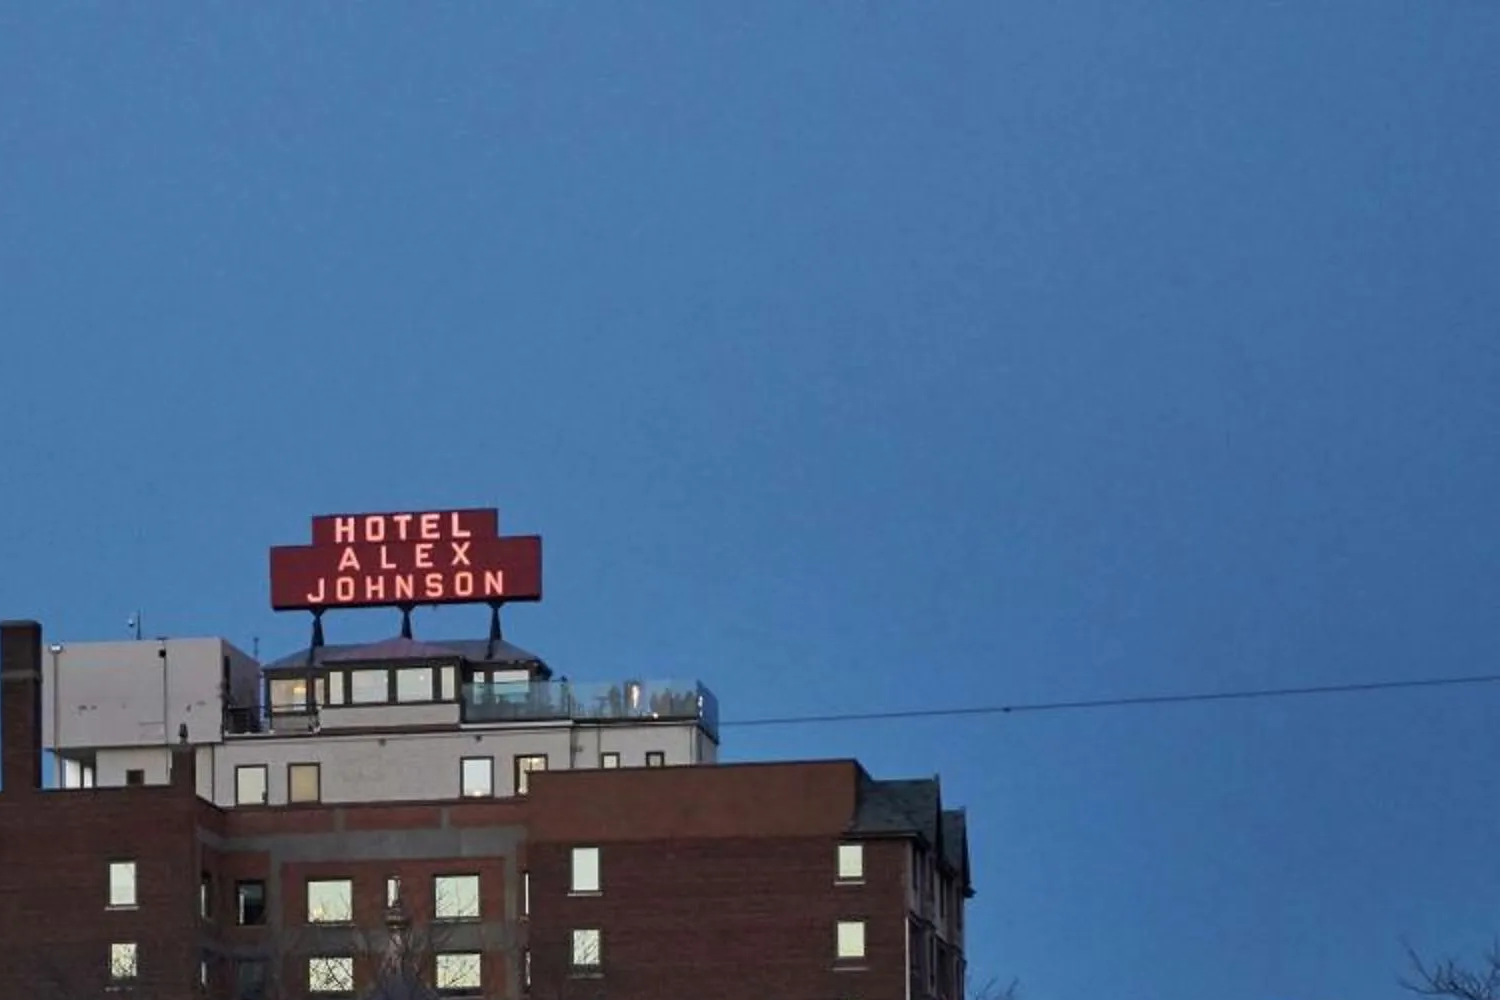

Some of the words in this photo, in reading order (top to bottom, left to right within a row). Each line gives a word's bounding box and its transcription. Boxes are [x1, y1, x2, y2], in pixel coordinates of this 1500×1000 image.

[334, 511, 471, 544] HOTEL
[338, 541, 471, 572] ALEX
[306, 570, 504, 603] JOHNSON
